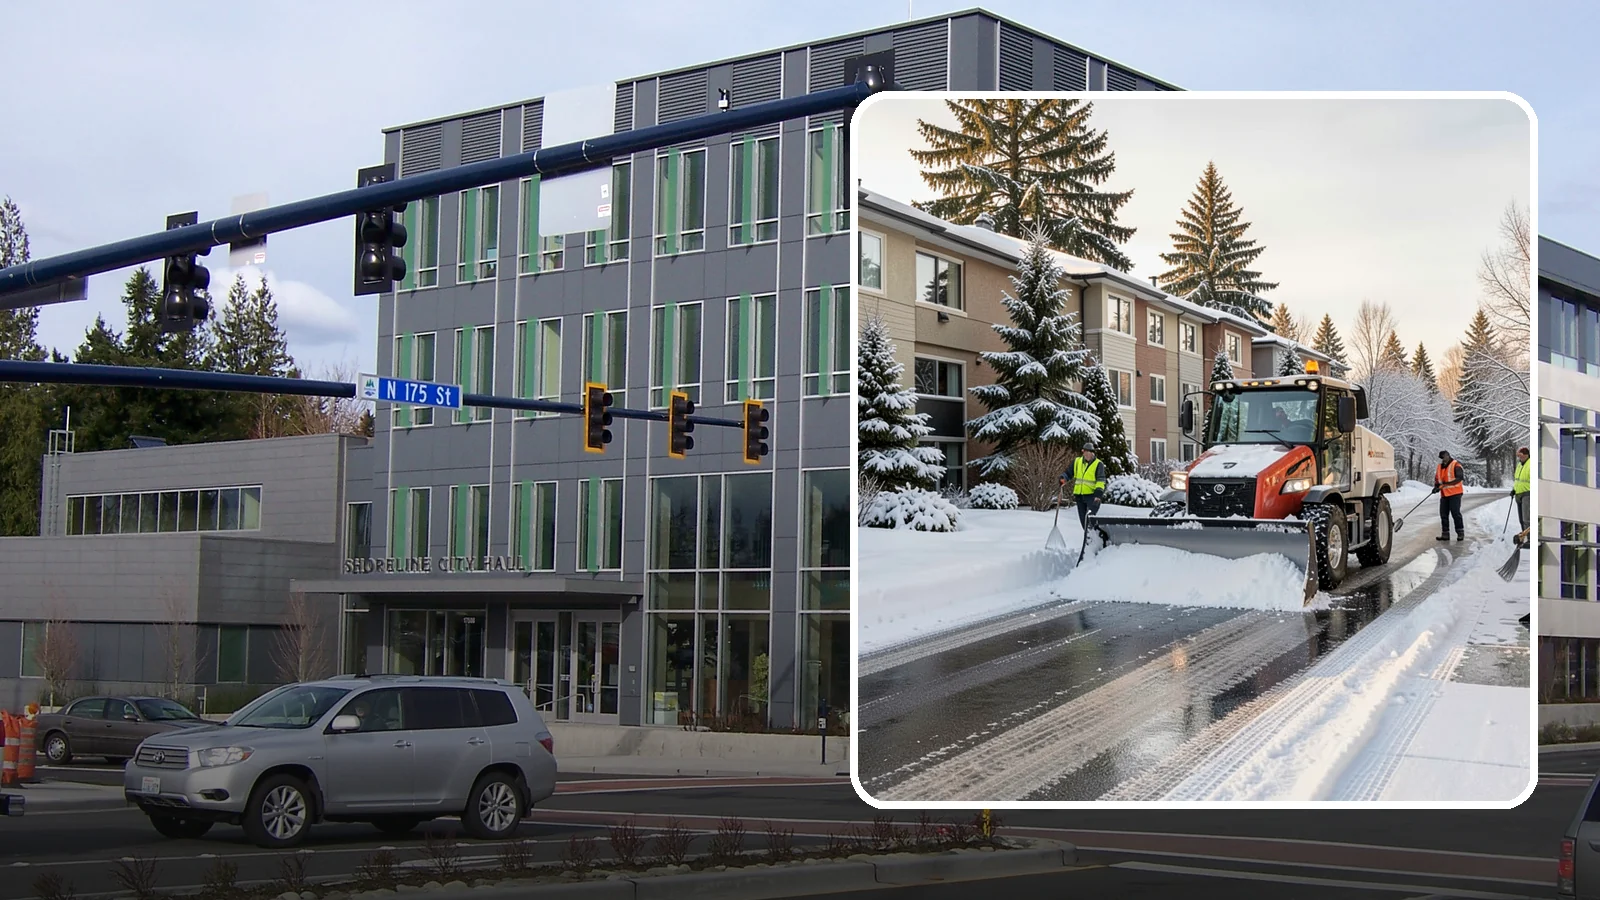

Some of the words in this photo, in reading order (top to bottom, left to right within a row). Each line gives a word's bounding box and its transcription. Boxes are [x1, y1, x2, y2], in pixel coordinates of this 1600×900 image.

[387, 381, 396, 400] N
[405, 382, 428, 403] 175
[436, 386, 452, 406] St
[344, 557, 431, 574] SHORELINE
[438, 556, 476, 572] CITY
[483, 555, 526, 571] HALL
